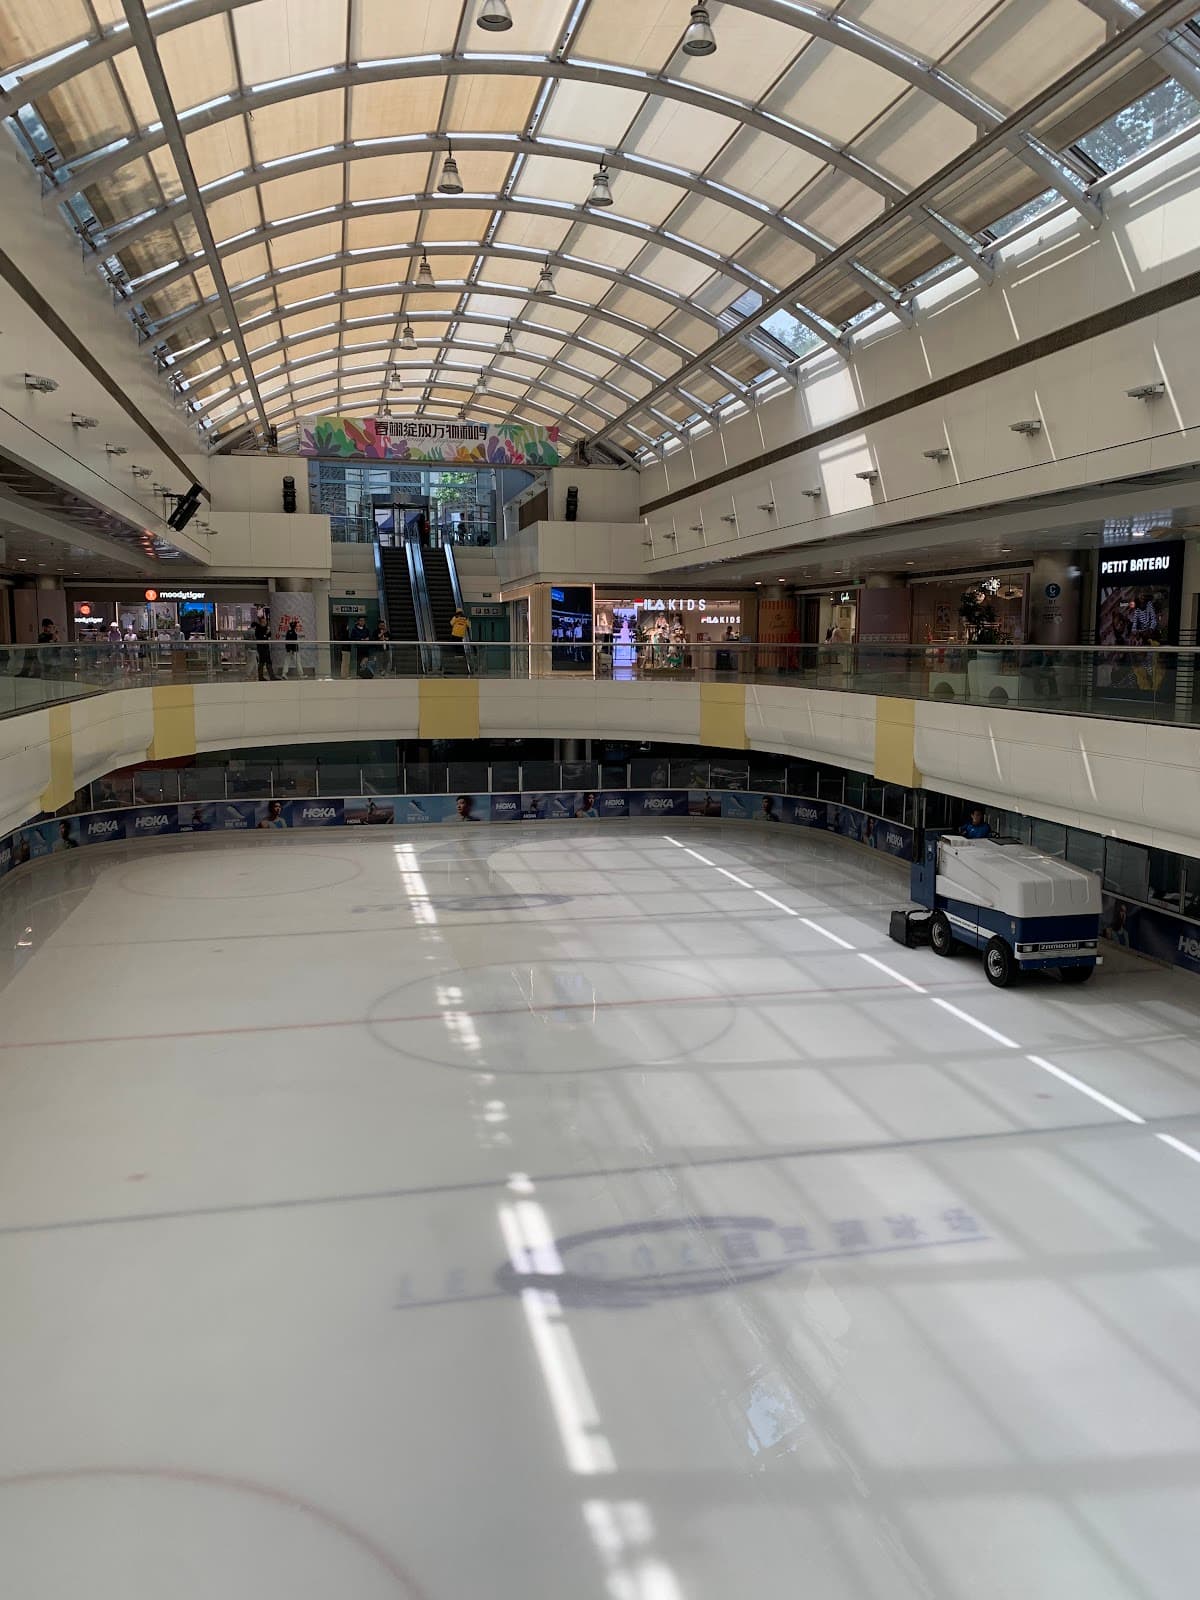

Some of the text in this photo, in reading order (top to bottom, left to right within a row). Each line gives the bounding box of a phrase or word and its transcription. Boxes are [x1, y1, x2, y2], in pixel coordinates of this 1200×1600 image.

[1102, 556, 1170, 574] PETIT BATEAU
[159, 591, 205, 600] moodytiger
[633, 598, 706, 611] FILA KIDS
[700, 614, 740, 624] FILA KIDS
[495, 802, 517, 810] HOKA
[643, 798, 674, 809] HOKA
[302, 807, 336, 818] HOKA
[795, 806, 818, 819] HOKA
[87, 819, 119, 835] HOKA
[135, 814, 169, 828] HOKA
[886, 831, 904, 848] HOKA
[1178, 935, 1200, 958] HO
